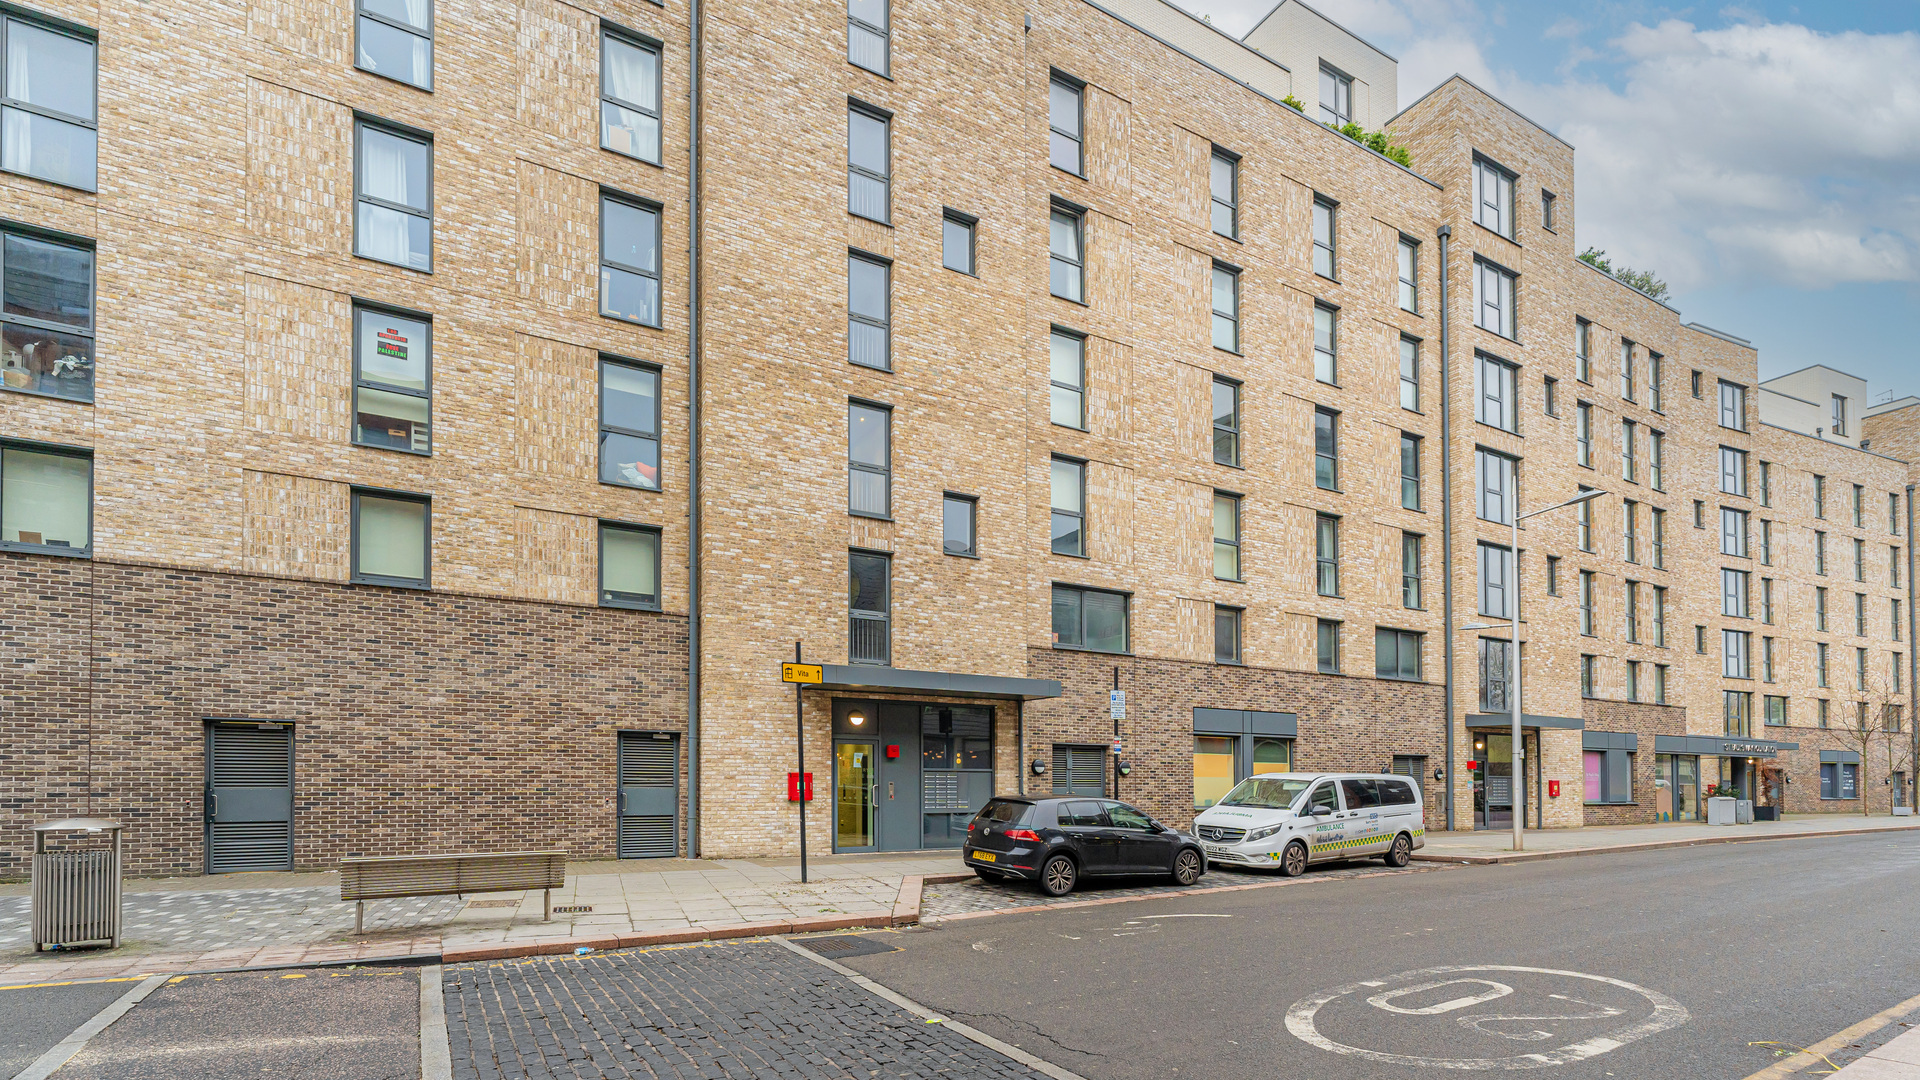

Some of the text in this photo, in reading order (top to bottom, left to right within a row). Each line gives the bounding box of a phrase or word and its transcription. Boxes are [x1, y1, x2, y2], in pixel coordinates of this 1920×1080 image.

[378, 347, 406, 358] PALESTINE
[797, 669, 809, 677] Vita
[1316, 822, 1345, 832] AMBULANCE
